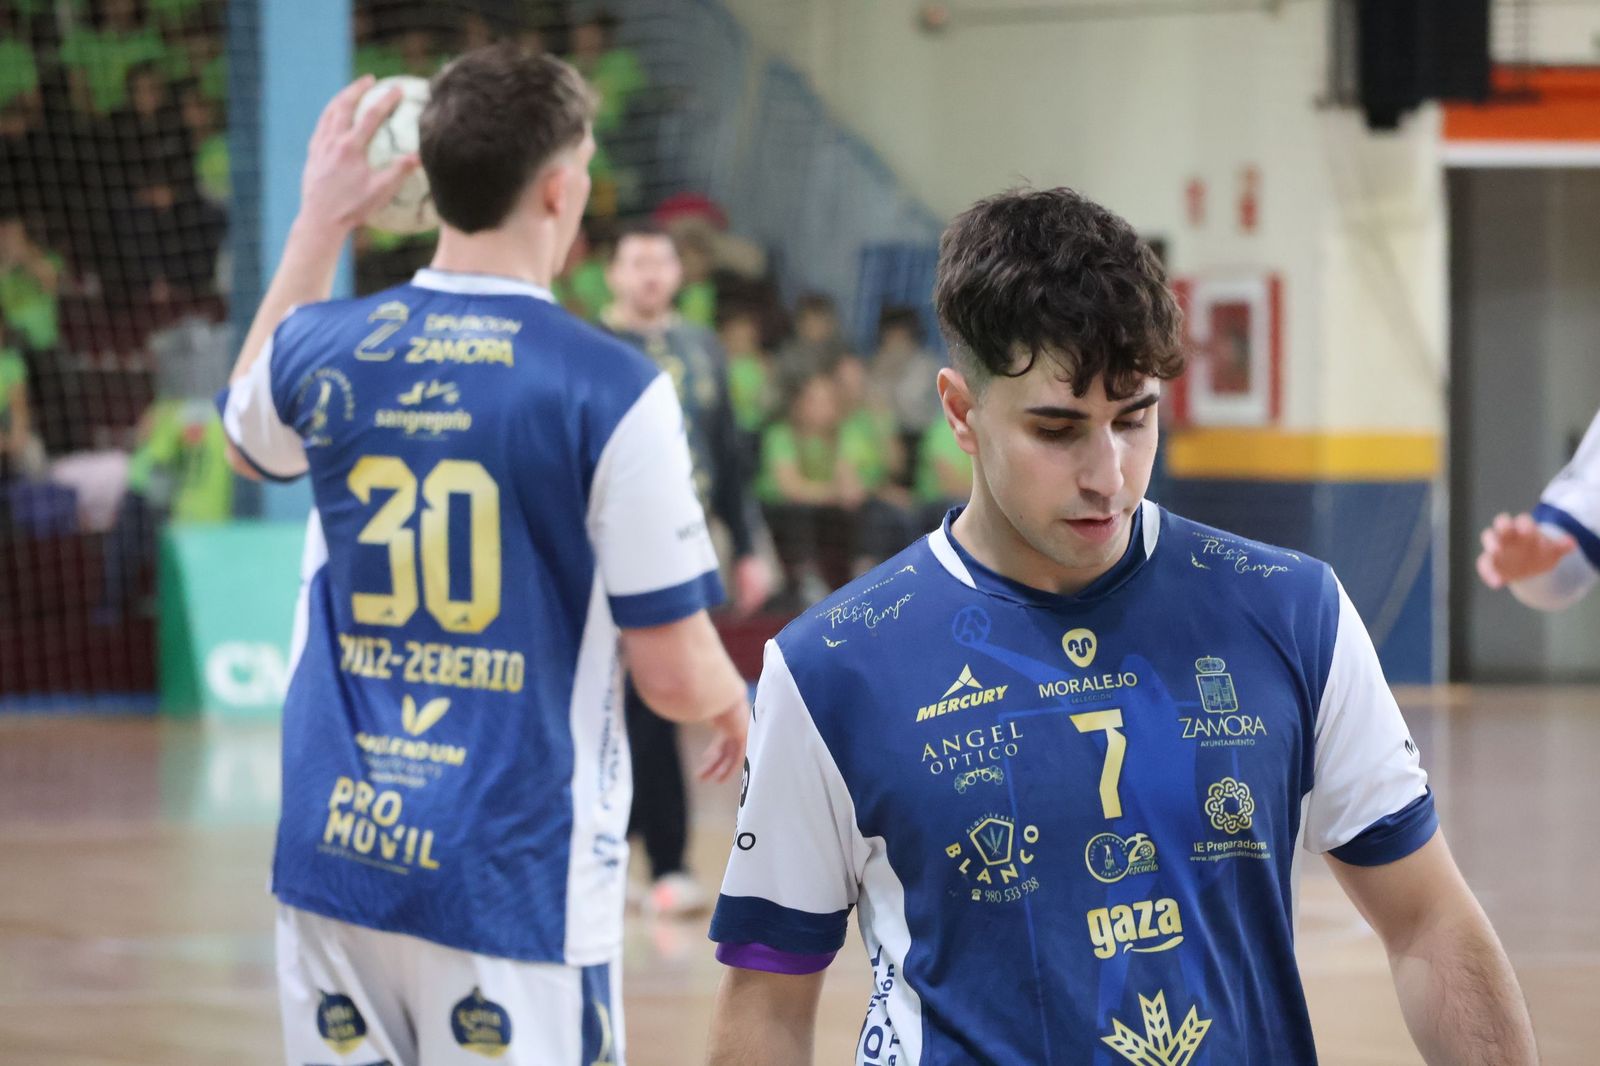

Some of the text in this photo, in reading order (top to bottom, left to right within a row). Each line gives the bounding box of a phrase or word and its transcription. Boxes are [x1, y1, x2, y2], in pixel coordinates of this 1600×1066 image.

[347, 456, 501, 633] 30
[864, 592, 916, 629] Campo
[915, 684, 1009, 723] MERCURY
[1038, 671, 1138, 699] MORALEJO
[920, 720, 1024, 763] ANGEL
[1177, 714, 1268, 739] ZAMORA
[1200, 738, 1256, 748] AYUNTAMIENTO
[929, 742, 1019, 775] OPTICO
[1068, 708, 1127, 819] 7
[327, 775, 403, 827] PRO
[944, 824, 1040, 885] BLANCO
[1193, 841, 1206, 853] IE
[984, 876, 1041, 903] 980 533 938
[1087, 897, 1184, 960] gaza
